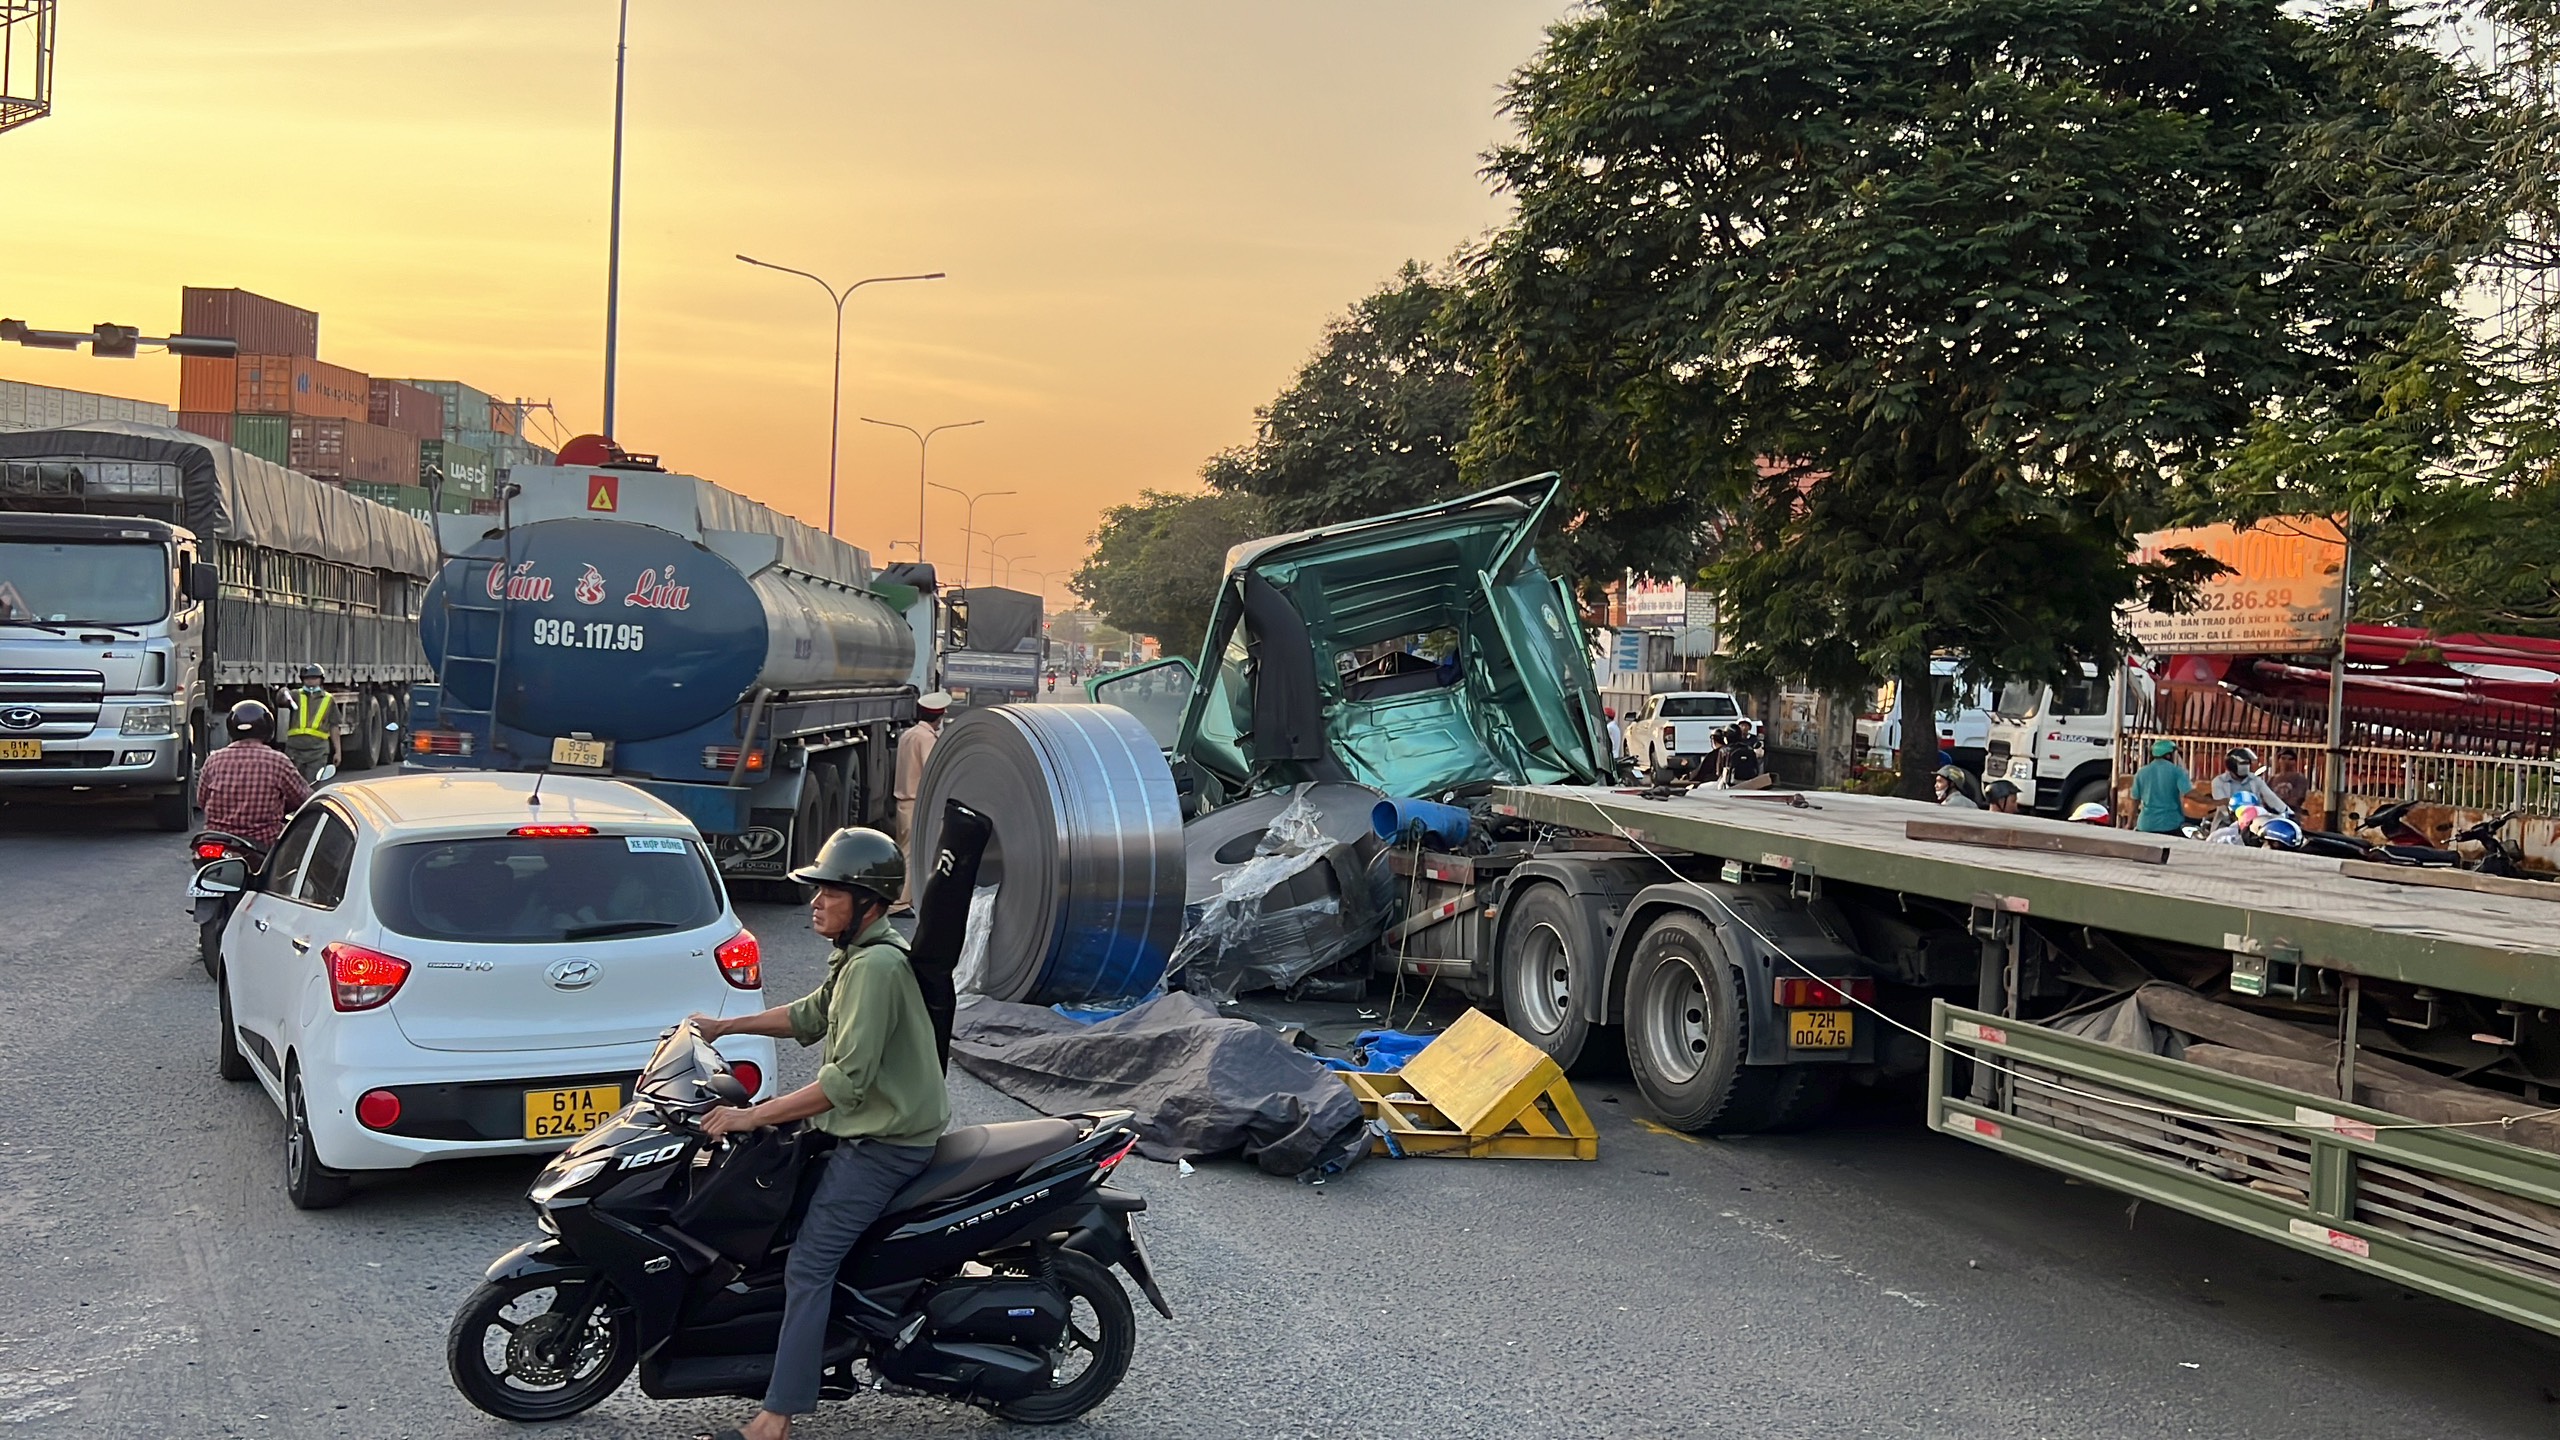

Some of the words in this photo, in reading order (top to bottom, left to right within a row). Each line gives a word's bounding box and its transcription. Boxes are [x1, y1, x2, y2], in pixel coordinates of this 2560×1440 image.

[410, 507, 431, 528] UA
[624, 565, 690, 611] Lửa
[2178, 588, 2292, 611] 82.86.89
[2154, 620, 2172, 628] MUA
[2202, 617, 2226, 626] TRAO
[2207, 631, 2219, 639] GA
[1613, 630, 1639, 670] HÀN
[3, 750, 37, 758] 5027
[568, 741, 591, 753] 93C
[631, 840, 642, 849] XE
[465, 960, 494, 972] i10
[1808, 1013, 1836, 1028] 72H
[1796, 1030, 1846, 1046] 004.76
[552, 1091, 594, 1112] 61A
[617, 1142, 685, 1171] 160
[945, 1188, 1050, 1236] AIRBLADE
